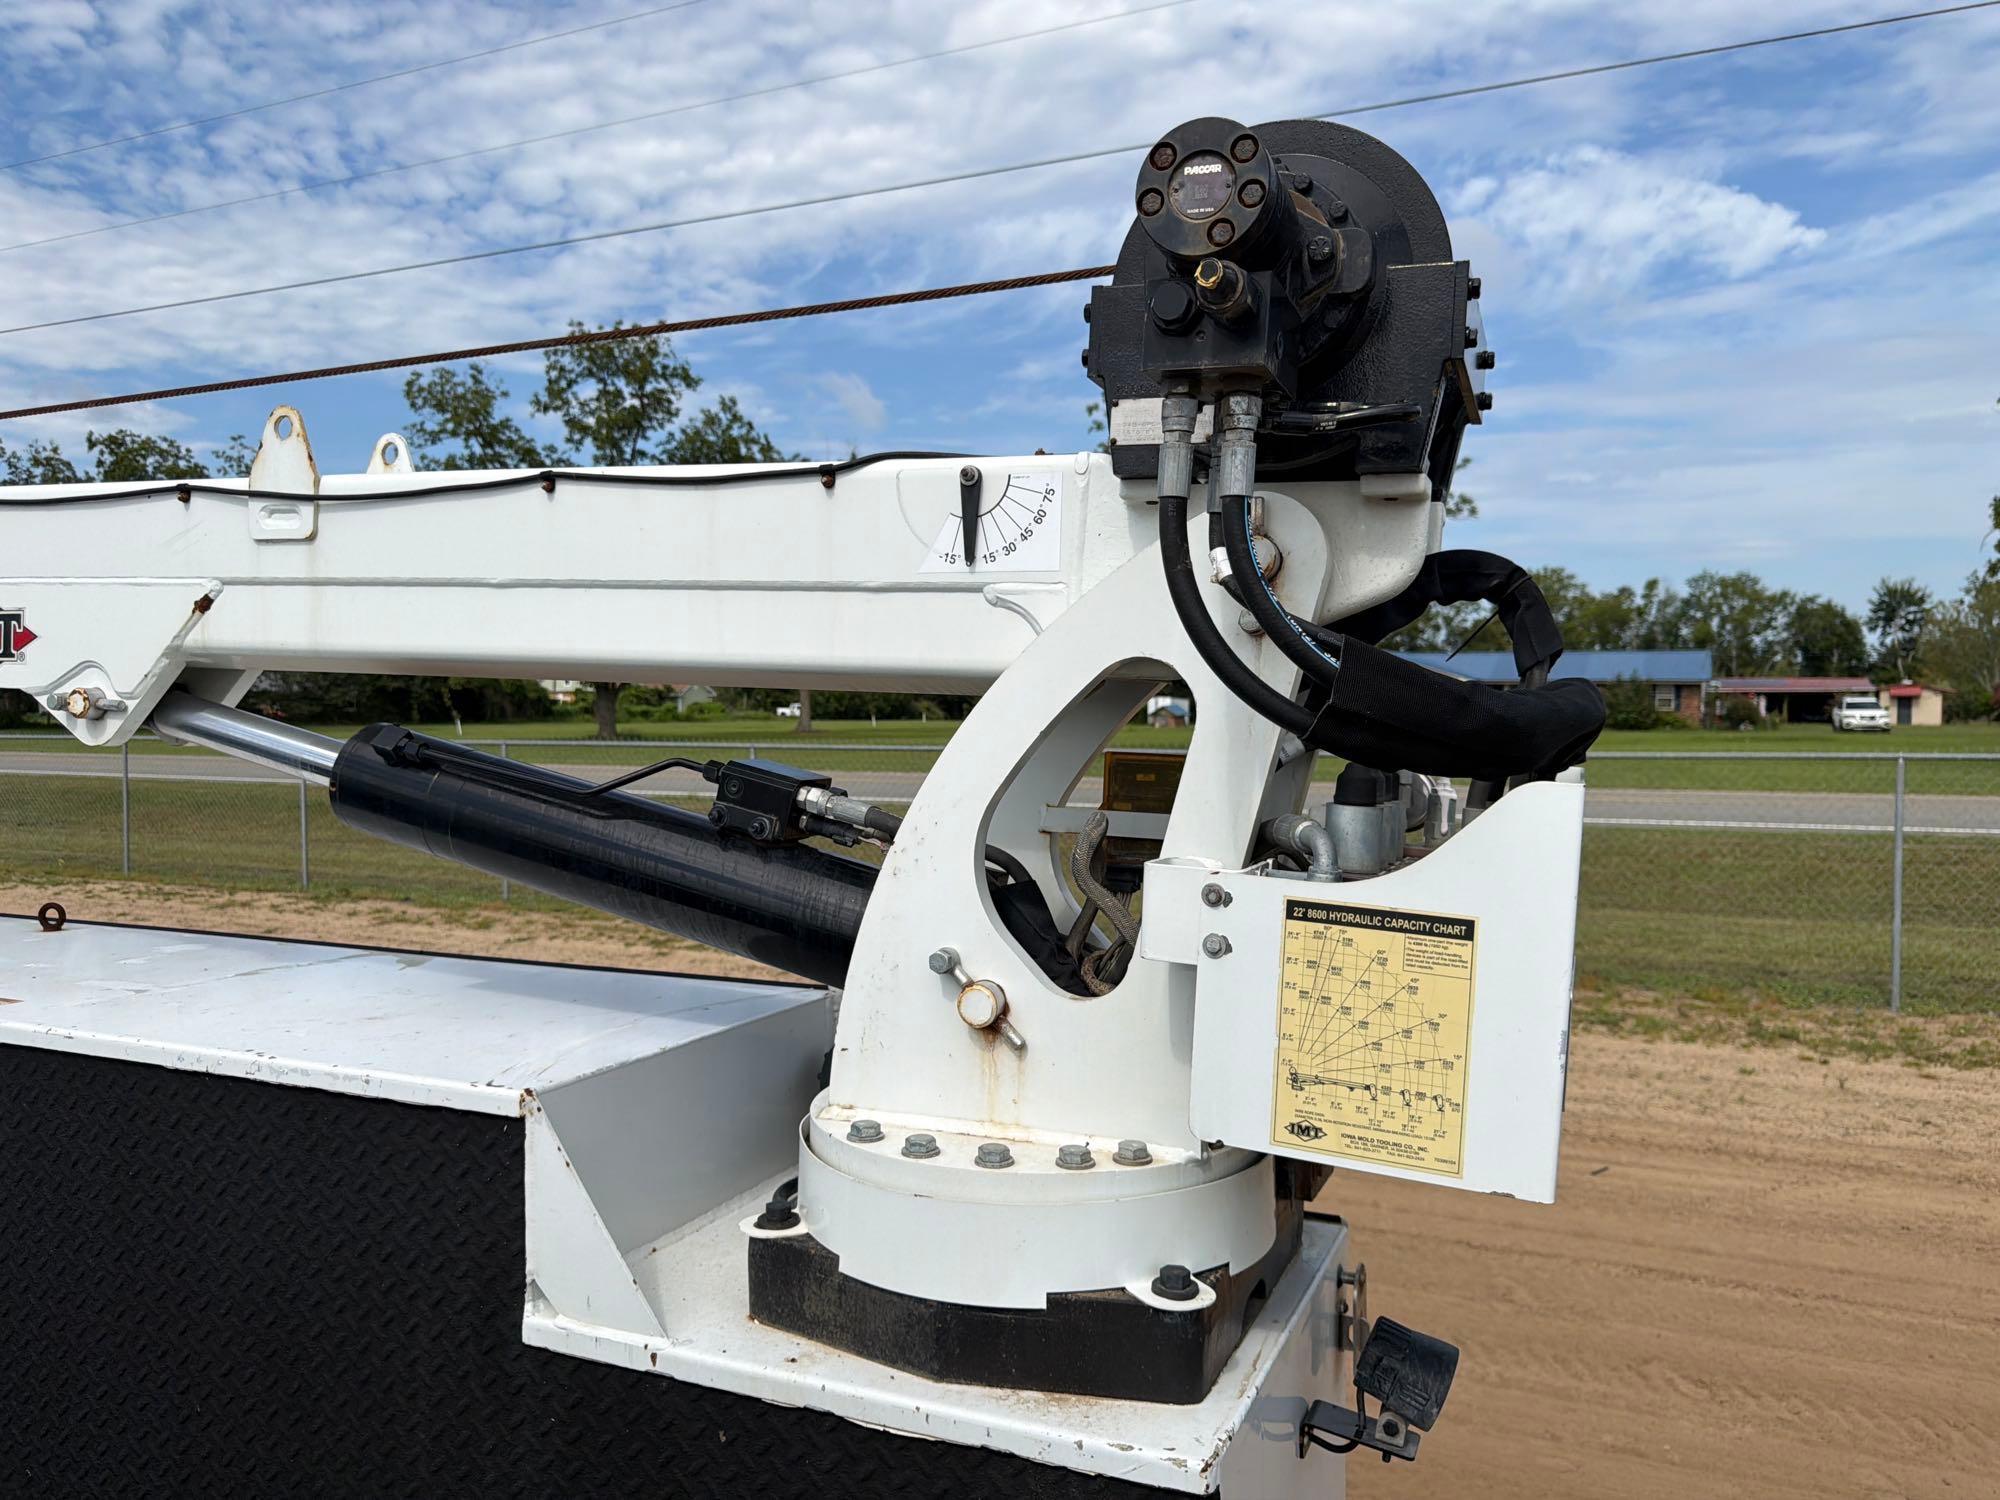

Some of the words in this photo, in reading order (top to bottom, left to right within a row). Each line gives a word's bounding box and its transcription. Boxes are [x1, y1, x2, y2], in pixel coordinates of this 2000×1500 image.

[1184, 164, 1222, 176] PACCAR
[1293, 907, 1306, 917] 22'
[1307, 908, 1327, 920] 8600
[1329, 911, 1382, 926] HYDRAULIC
[1384, 918, 1431, 931] CAPACITY
[1433, 923, 1466, 936] CHART
[1289, 1121, 1323, 1139] IMT
[1376, 1139, 1402, 1147] TOOLING
